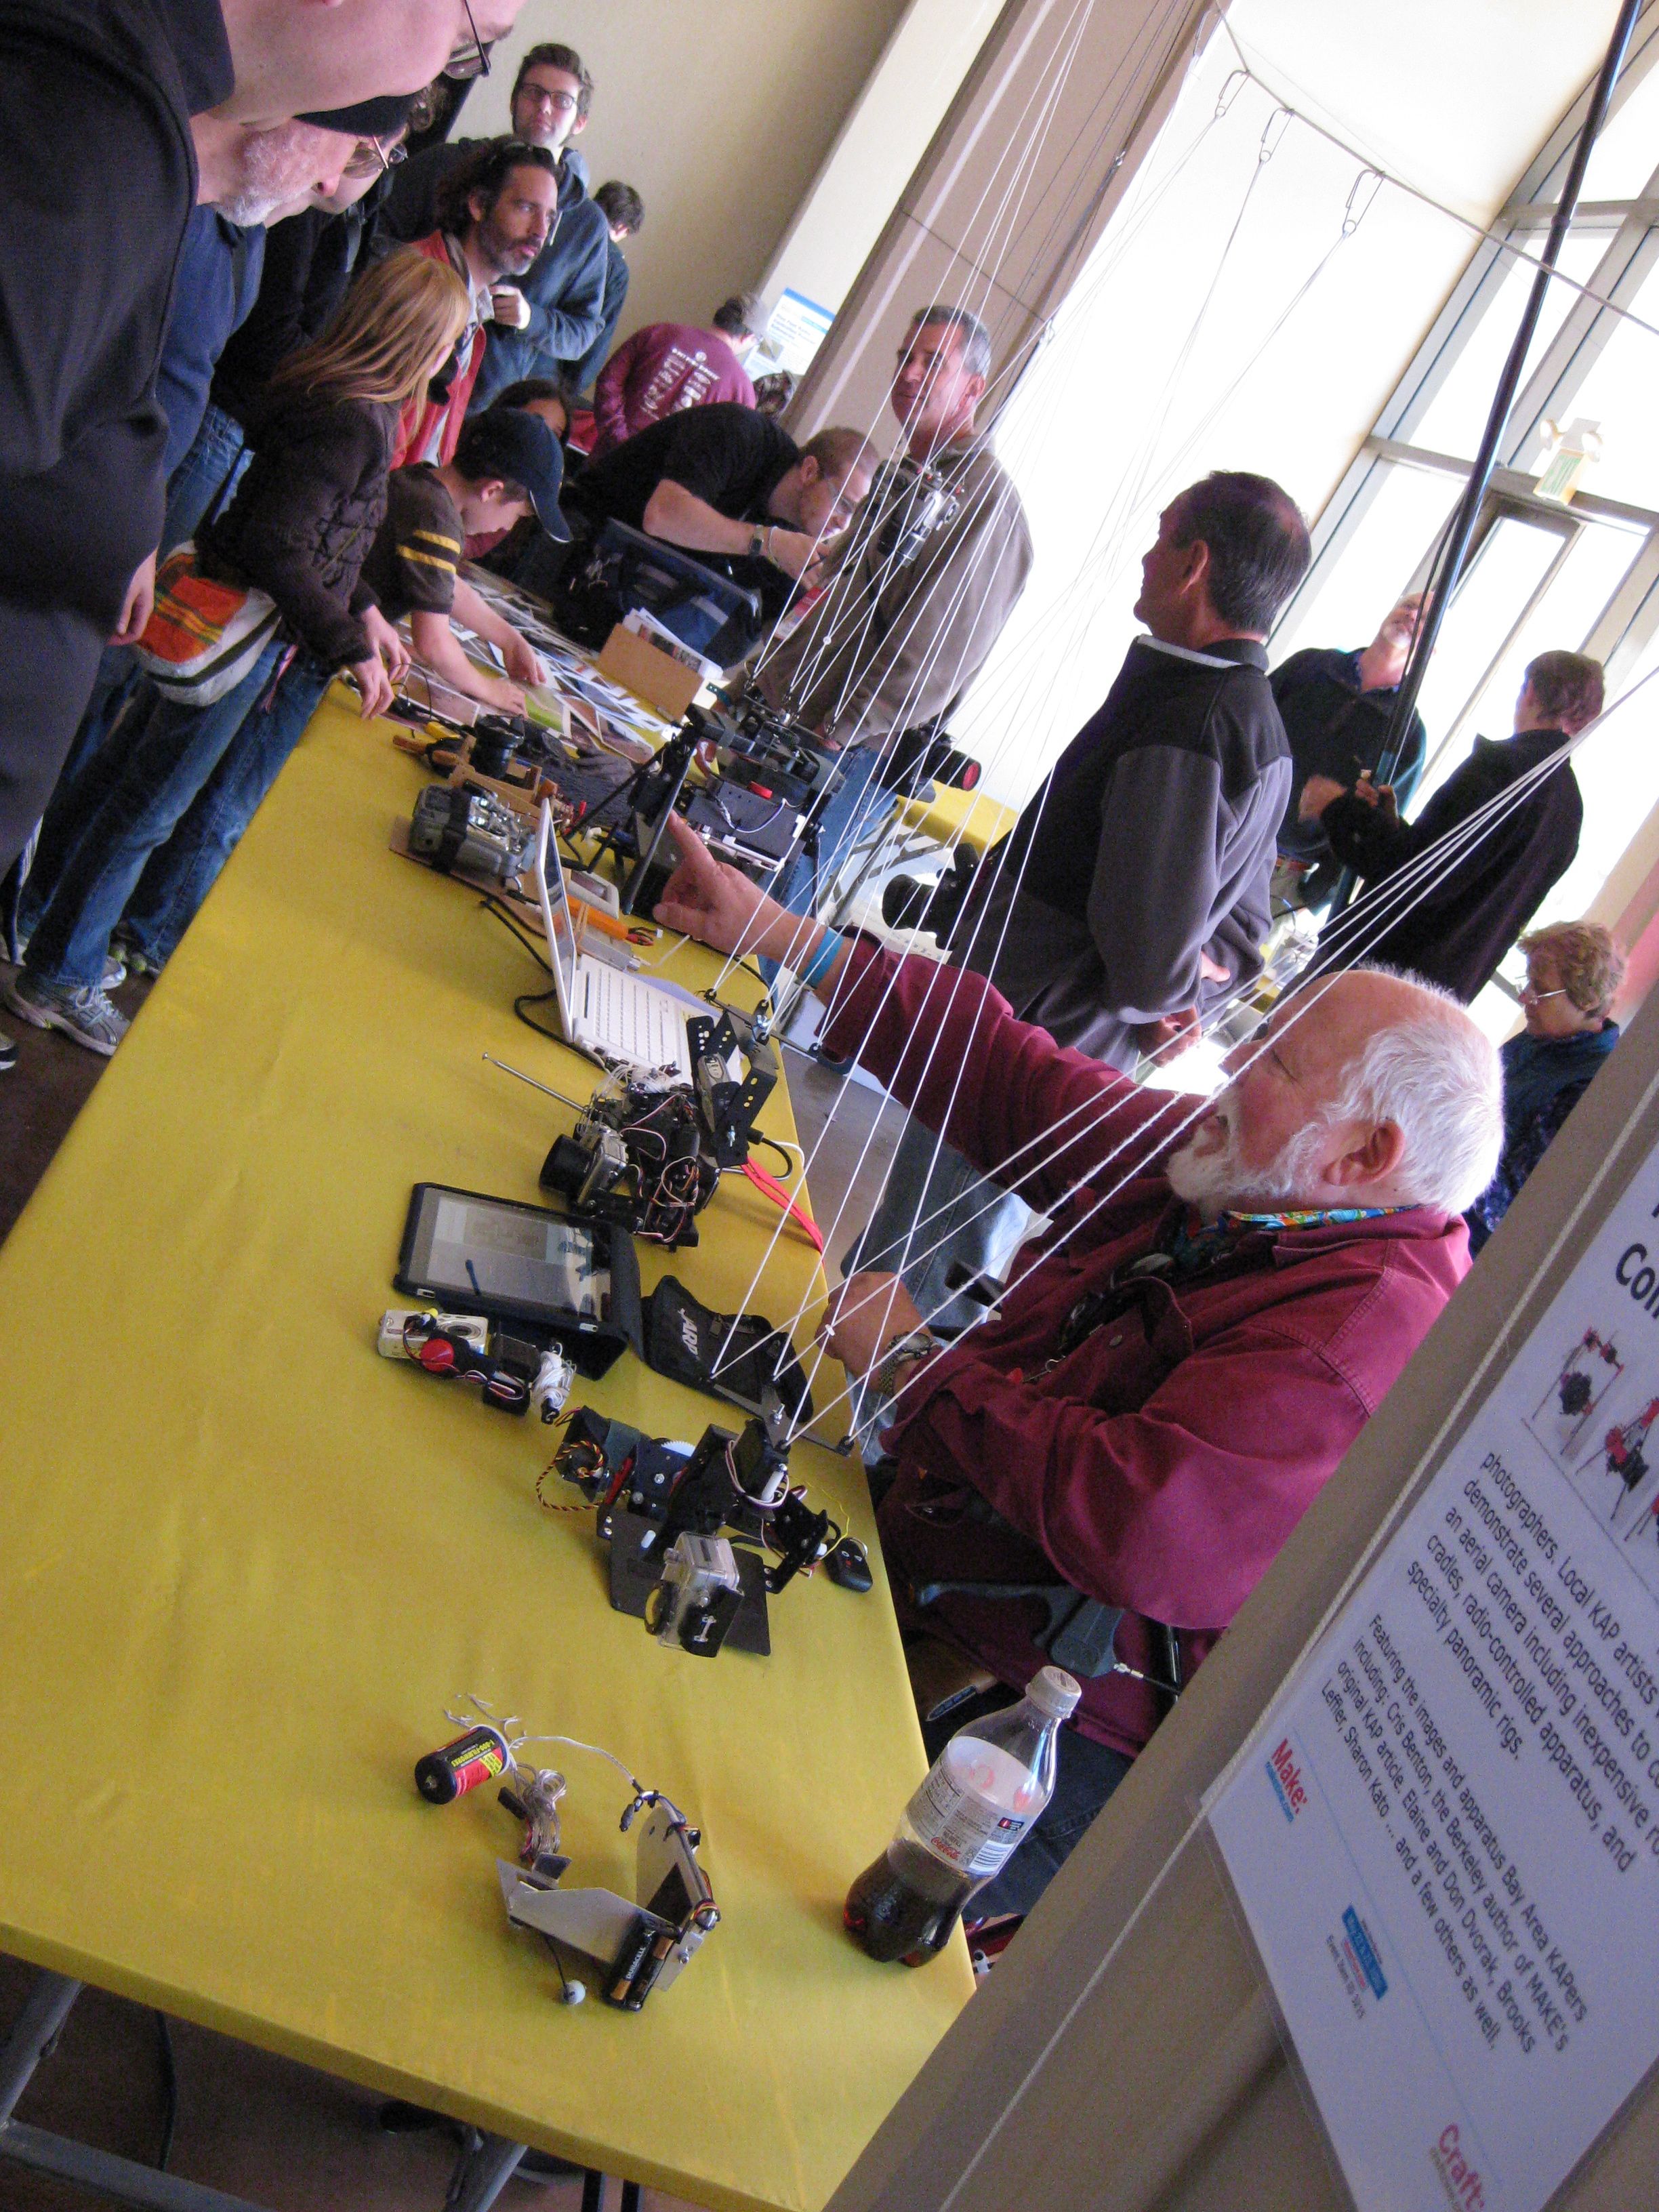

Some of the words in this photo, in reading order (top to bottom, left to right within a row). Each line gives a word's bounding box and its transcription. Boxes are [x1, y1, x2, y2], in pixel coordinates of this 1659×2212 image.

[1408, 1561, 1451, 1632] specialty
[1444, 1628, 1501, 1718] panoramic
[1496, 1715, 1522, 1760] rigs.
[1427, 1535, 1463, 1599] cradles,
[1463, 1593, 1547, 1725] radio-controlled
[1540, 1722, 1602, 1830] apparatus,
[1602, 1826, 1637, 1872] and
[1446, 1507, 1462, 1532] an
[1459, 1528, 1492, 1575] aerial
[1487, 1572, 1527, 1635] camera
[1523, 1626, 1576, 1716] including
[1573, 1704, 1649, 1828] inexpensive
[1464, 1480, 1528, 1575] demonstrate
[1524, 1572, 1570, 1633] several
[1563, 1631, 1635, 1737] approaches
[1631, 1730, 1650, 1761] to
[1480, 1452, 1558, 1564] photographers.
[1558, 1556, 1595, 1607] Local
[1589, 1601, 1620, 1640] KAP
[1614, 1642, 1659, 1705] artists
[1271, 1738, 1307, 1814] Make:
[1338, 1661, 1368, 1712] original
[1363, 1708, 1382, 1738] KAP
[1377, 1741, 1404, 1793] article.
[1402, 1789, 1430, 1842] Elaine
[1427, 1841, 1449, 1875] and
[1443, 1871, 1465, 1912] Don
[1462, 1908, 1498, 1986] Dvorak,
[1496, 1980, 1536, 2053] Brooks
[1344, 1727, 1372, 1782] Sharon
[1369, 1778, 1389, 1818] Kato
[1396, 1838, 1417, 1871] and
[1412, 1870, 1422, 1886] a
[1418, 1881, 1438, 1918] few
[1435, 1919, 1466, 1977] others
[1462, 1976, 1478, 2002] as
[1353, 1639, 1389, 1705] including:
[1387, 1702, 1406, 1736] Cris
[1401, 1730, 1432, 1795] Benton,
[1432, 1789, 1450, 1822] the
[1446, 1818, 1486, 1893] Berkeley
[1483, 1893, 1519, 1951] author
[1515, 1954, 1534, 1975] of
[1526, 1973, 1568, 2051] MAKE's
[1369, 1614, 1406, 1683] Featuring
[1402, 1677, 1418, 1706] the
[1416, 1700, 1447, 1758] images
[1443, 1757, 1465, 1789] and
[1460, 1788, 1506, 1870] apparatus
[1502, 1865, 1524, 1905] Bay
[1521, 1904, 1549, 1951] Area
[1547, 1947, 1587, 2022] KAPers
[626, 1947, 646, 1979] DURACELL
